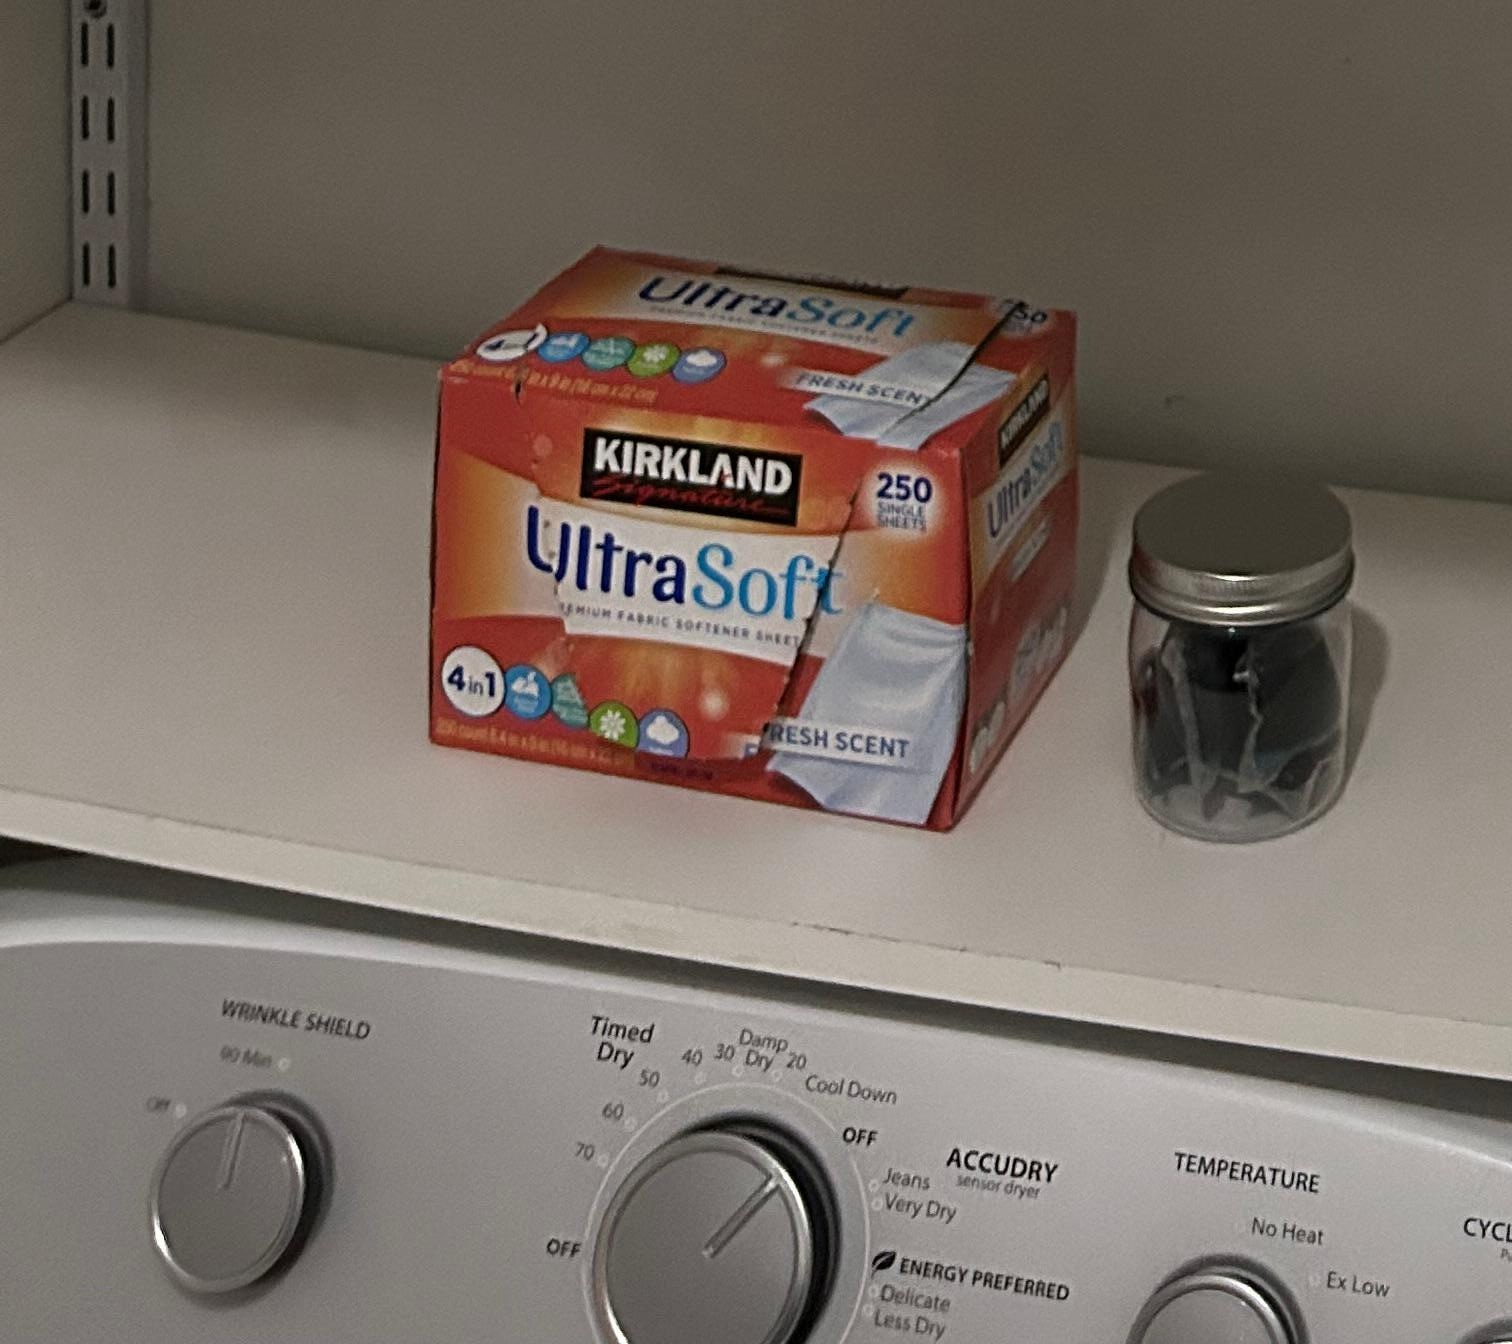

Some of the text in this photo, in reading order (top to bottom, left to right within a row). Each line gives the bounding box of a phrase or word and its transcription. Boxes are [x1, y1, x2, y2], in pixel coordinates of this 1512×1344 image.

[796, 373, 865, 396] FRESH
[594, 437, 793, 495] KIRKLAND
[877, 472, 933, 504] 250
[876, 502, 925, 517] SINGLE
[876, 515, 928, 531] SHEETS
[617, 610, 670, 628] FABRIC
[675, 617, 749, 638] SOFTENER
[834, 731, 911, 758] SCENT
[221, 998, 371, 1040] WRINKLE SHIELD
[591, 1014, 656, 1044] Timed
[713, 1043, 735, 1062] 30
[739, 1027, 788, 1053] Damp
[596, 1041, 635, 1070] Dry
[681, 1048, 703, 1067] 40
[745, 1049, 775, 1073] Dry
[786, 1052, 807, 1070] 20
[639, 1068, 661, 1089] 50
[805, 1073, 898, 1105] Cool Down
[601, 1103, 625, 1121] 60
[842, 1126, 878, 1147] OFF
[575, 1141, 595, 1161] 70
[883, 1167, 931, 1190] Jeans
[946, 1147, 1059, 1183] ACCUDRY
[1174, 1151, 1321, 1194] TEMPERATURE
[955, 1174, 1041, 1201] sensor dryer
[884, 1192, 957, 1223] Very Dry
[1250, 1216, 1325, 1246] No Heat
[546, 1238, 582, 1260] OFF
[900, 1256, 1071, 1302] ENERGY PREFERRED
[1326, 1270, 1391, 1298] Ex Low
[880, 1282, 951, 1313] Delicate
[874, 1309, 946, 1343] Less Dry
